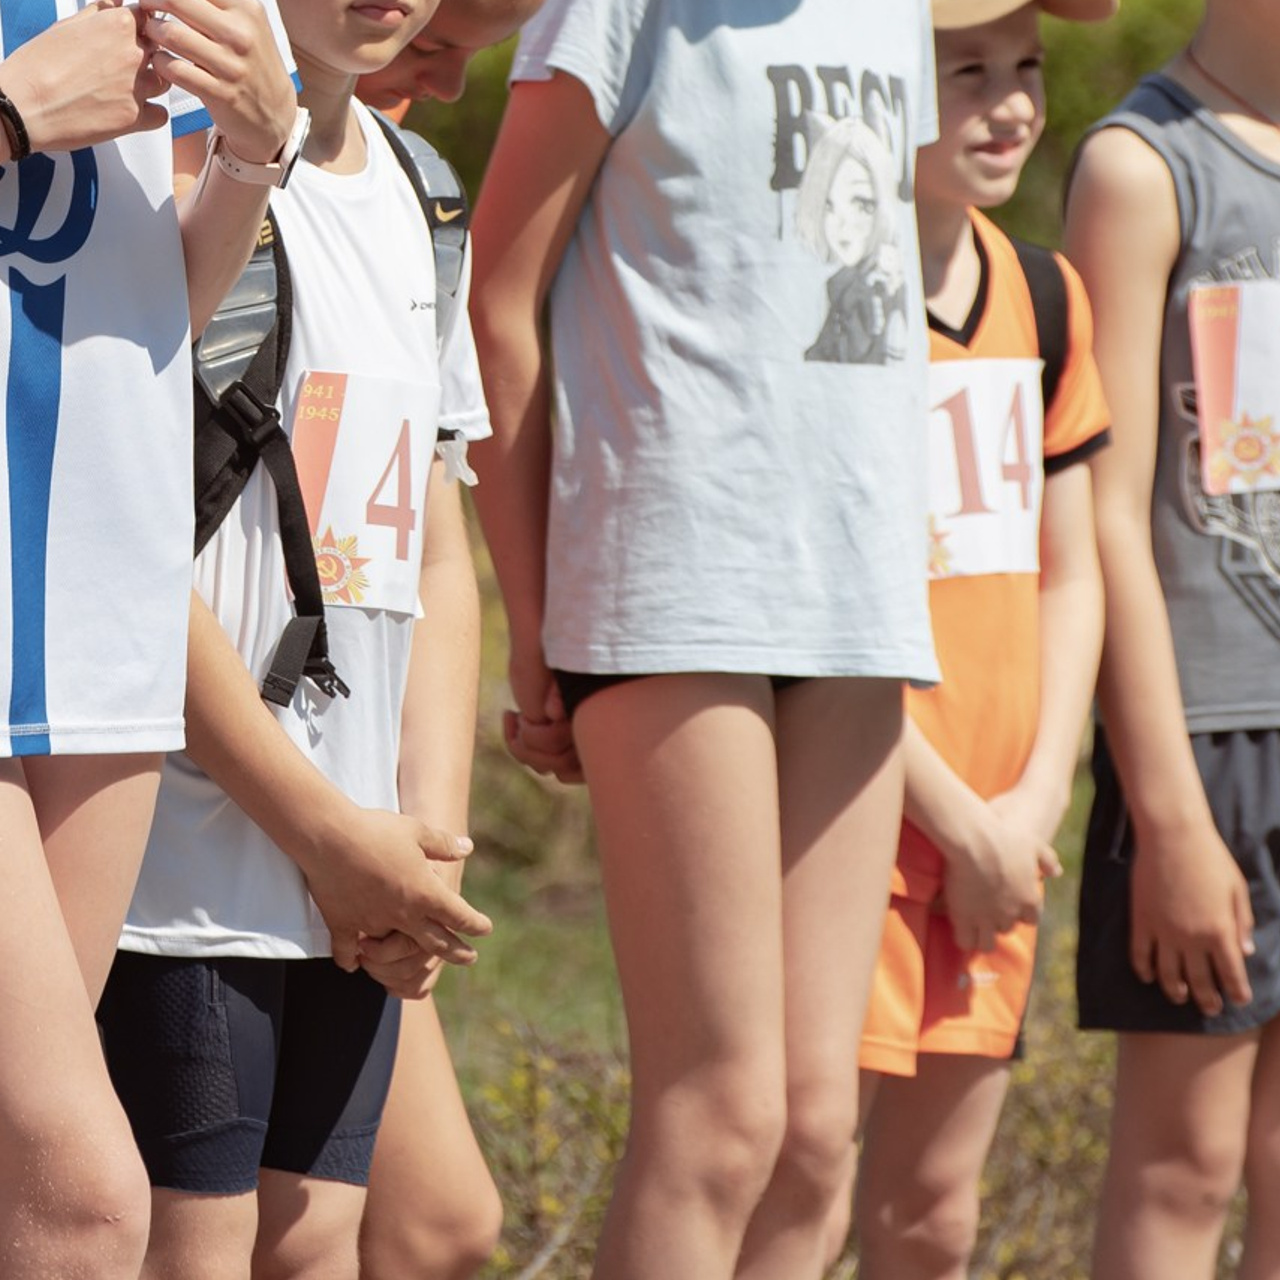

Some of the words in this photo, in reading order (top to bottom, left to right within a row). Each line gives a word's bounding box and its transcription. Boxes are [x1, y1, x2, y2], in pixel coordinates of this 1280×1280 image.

[298, 406, 341, 422] 1945
[303, 384, 335, 399] 941
[930, 382, 1033, 518] 14
[366, 419, 417, 561] 4
